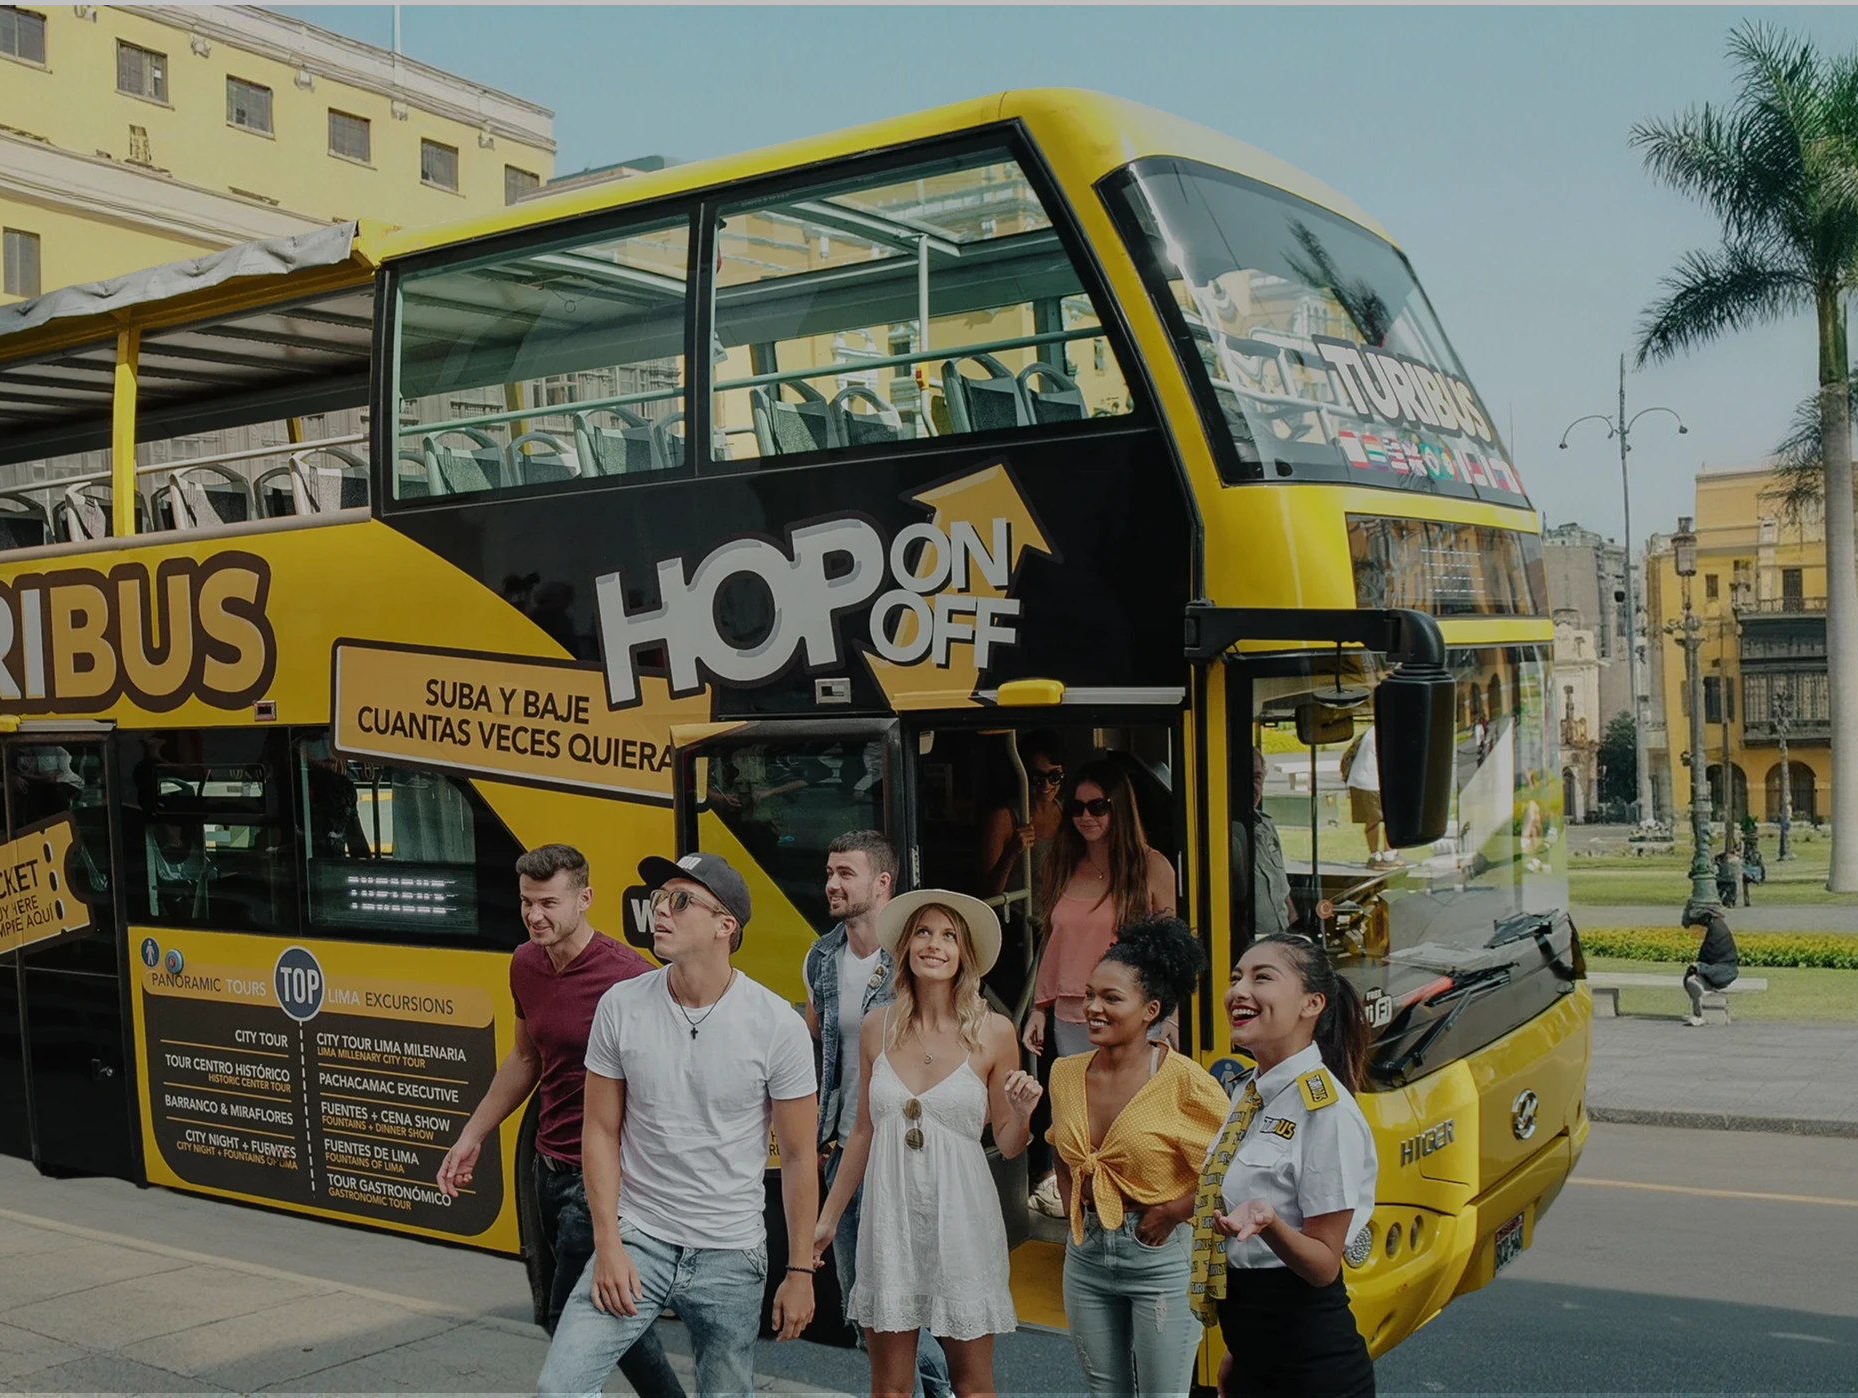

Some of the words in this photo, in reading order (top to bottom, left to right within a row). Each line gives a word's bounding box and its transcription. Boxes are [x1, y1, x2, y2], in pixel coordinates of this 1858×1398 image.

[1317, 343, 1491, 443] TURIBUS
[890, 517, 1010, 593] ON
[596, 518, 885, 705] HOP
[869, 588, 1021, 668] OFF
[425, 678, 493, 713] SUBA
[498, 687, 517, 715] Y
[523, 689, 590, 725] BAJE
[357, 705, 471, 746] CUANTAS
[478, 720, 561, 759] VECES
[27, 903, 54, 929] AQUÍ
[152, 972, 222, 992] PANORAMIC
[226, 978, 267, 997] TOURS
[280, 966, 320, 1004] TOP
[1366, 989, 1382, 1001] FREE
[328, 988, 361, 1006] LIMA
[365, 992, 454, 1016] EXCURSIONS
[235, 1030, 258, 1044] CITY
[259, 1033, 288, 1048] TOUR
[316, 1032, 340, 1047] CITY
[342, 1035, 372, 1050] TOUR
[374, 1039, 401, 1054] LIMA
[403, 1042, 466, 1062] MILENARIA
[165, 1053, 192, 1069] TOUR
[193, 1057, 233, 1074] CENTRO
[235, 1063, 290, 1083] HISTÓRICO
[317, 1046, 336, 1058] LIMA
[337, 1049, 382, 1064] MILLENARY
[382, 1055, 401, 1065] CITY
[403, 1057, 426, 1068] TOUR
[208, 1073, 240, 1087] HISTORIC
[242, 1077, 270, 1090] CENTER
[270, 1081, 291, 1093] TOUR
[319, 1072, 395, 1095] PACHACAMAC
[397, 1083, 459, 1103] EXECUTIVE
[164, 1094, 218, 1114] BARRANCO
[220, 1105, 228, 1115] &
[230, 1104, 294, 1126] MIRAFLORES
[321, 1101, 368, 1120] FUENTES
[371, 1111, 378, 1121] +
[380, 1110, 412, 1127] CENA
[414, 1114, 451, 1132] SHOW
[321, 1115, 367, 1131] FOUNTAINS
[369, 1124, 374, 1132] +
[375, 1124, 407, 1137] DINNER
[408, 1128, 435, 1141] SHOW
[176, 1140, 193, 1151] CITY
[194, 1144, 215, 1156] NIGHT
[223, 1149, 265, 1165] FOUNTAINS
[185, 1129, 206, 1144] CITY
[208, 1133, 239, 1149] NIGHT
[242, 1141, 249, 1151] +
[251, 1140, 297, 1159] FUENTES
[324, 1138, 372, 1157] FUENTES
[374, 1148, 389, 1160] DE
[391, 1150, 420, 1165] LIMA
[1400, 1119, 1454, 1168] HIGER
[325, 1152, 370, 1168] FOUNTAINS
[371, 1158, 383, 1169] OF
[384, 1161, 405, 1174] LIMA
[327, 1173, 357, 1190] TOUR
[359, 1178, 452, 1207] GASTRONÓMICO
[328, 1187, 388, 1207] GASTRONOMIC
[389, 1199, 412, 1210] TOUR
